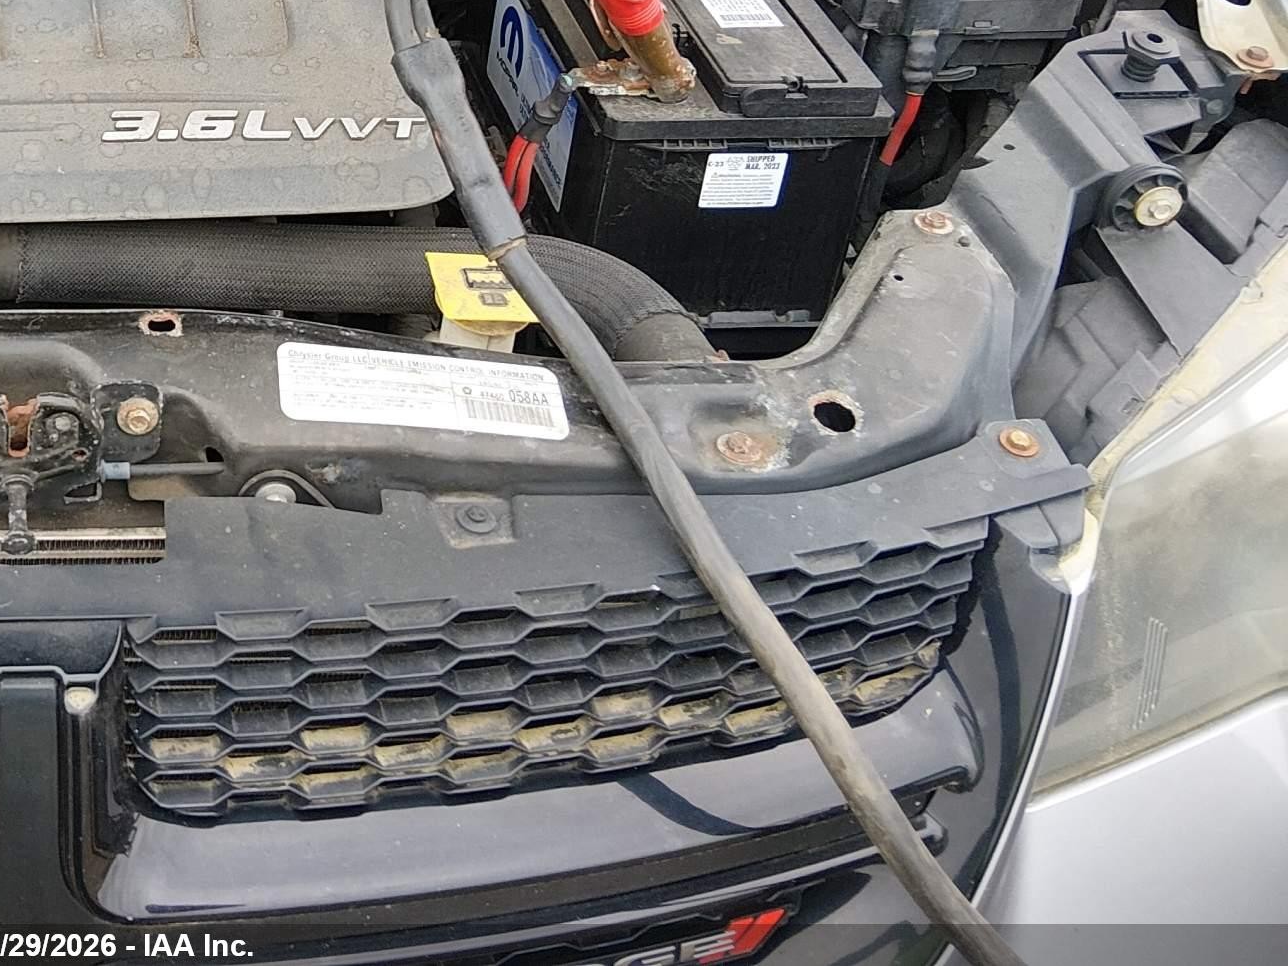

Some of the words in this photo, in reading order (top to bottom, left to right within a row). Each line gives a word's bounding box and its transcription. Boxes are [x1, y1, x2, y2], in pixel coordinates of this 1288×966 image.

[101, 109, 292, 142] 3.6L
[293, 116, 426, 141] VVT
[325, 353, 349, 363] Group
[408, 361, 446, 371] EMISSION
[488, 369, 544, 381] INFORMATION
[508, 388, 550, 405] 058AA
